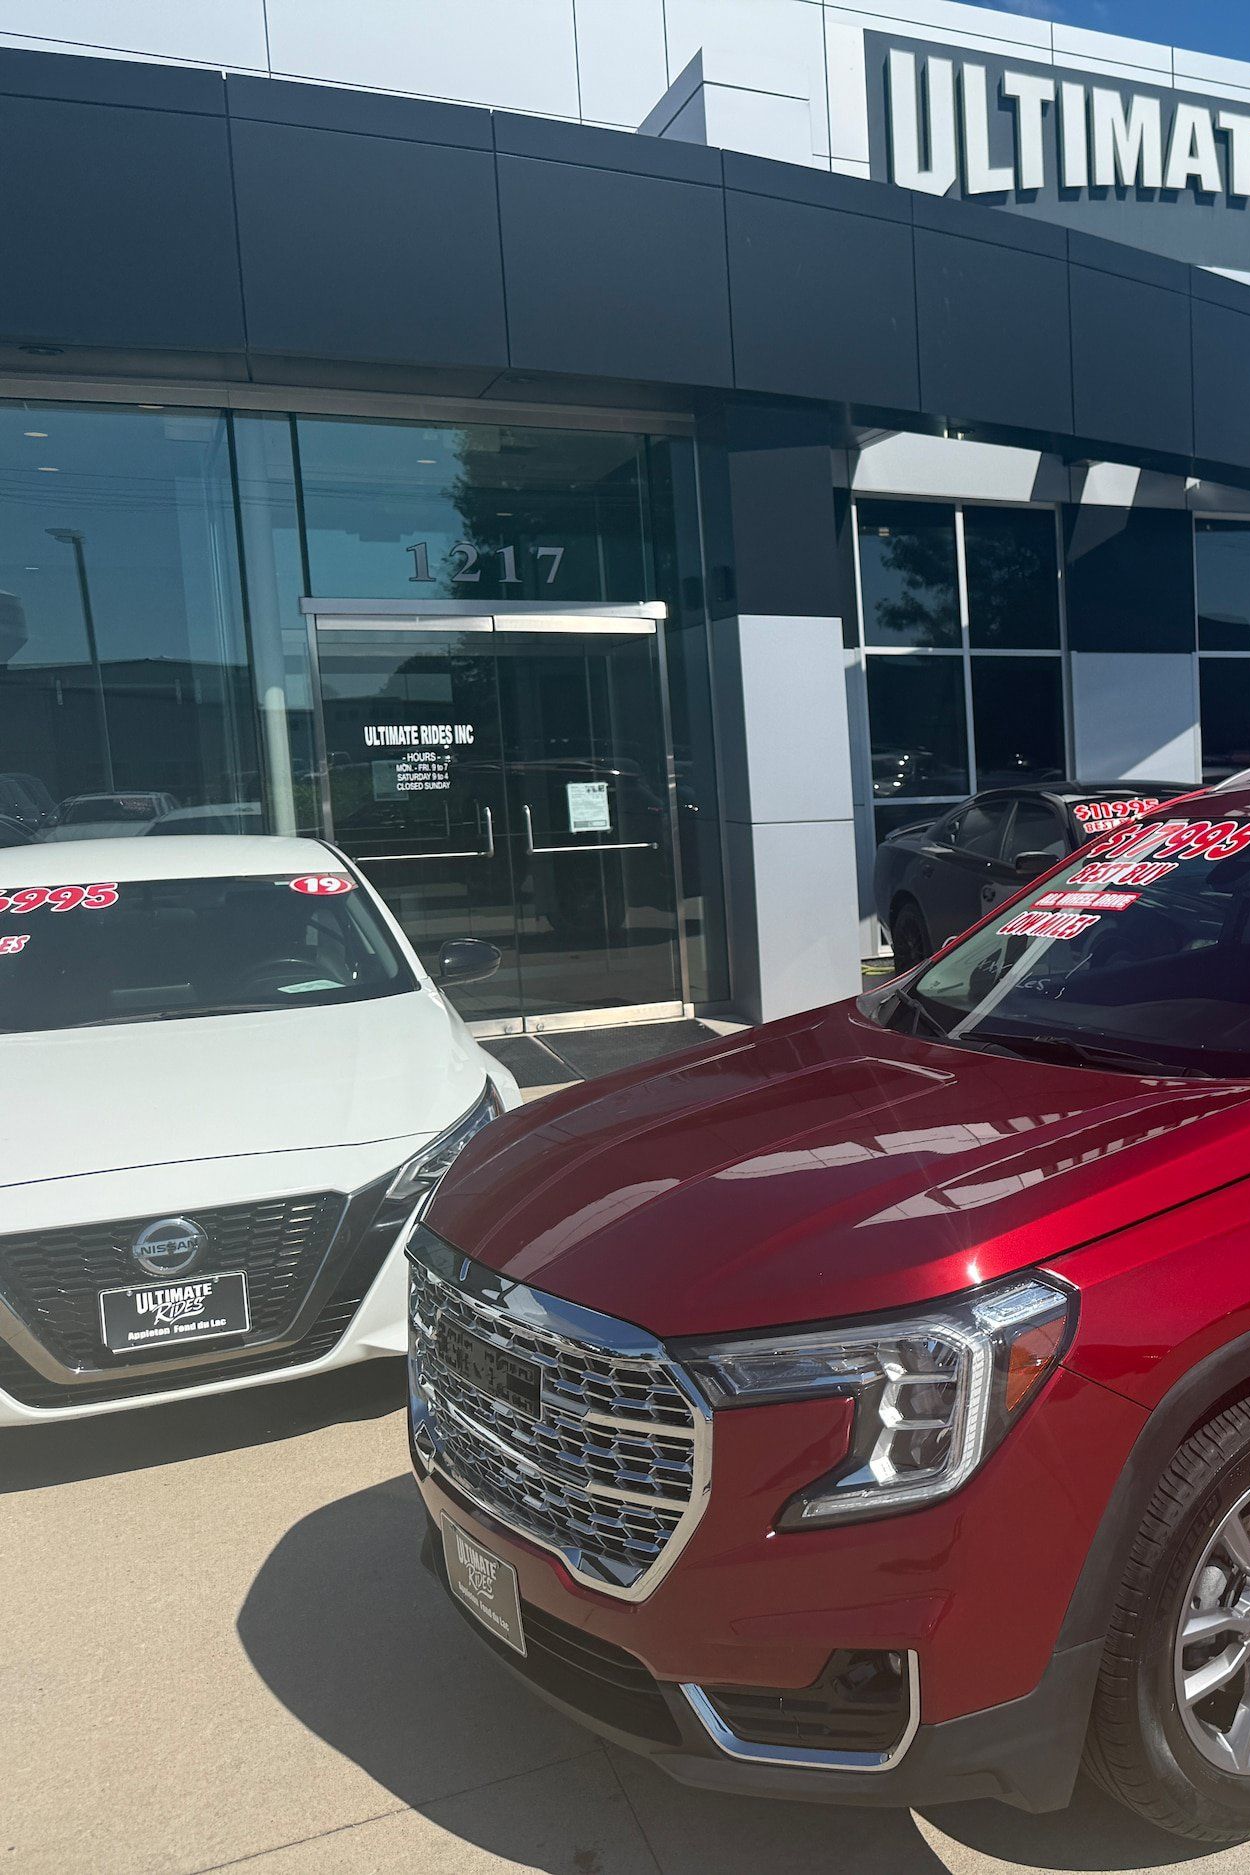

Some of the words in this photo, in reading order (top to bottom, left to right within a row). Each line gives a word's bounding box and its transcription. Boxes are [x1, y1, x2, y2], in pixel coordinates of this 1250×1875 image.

[406, 541, 565, 584] 1217
[364, 725, 419, 746] ULTIMATE
[420, 725, 453, 745] RIDES
[454, 725, 474, 744] INC
[407, 752, 436, 762] HOURS
[396, 782, 423, 791] CLOSED
[424, 782, 451, 790] SUNDAY
[397, 773, 431, 781] SATURDAY
[1066, 861, 1131, 885] BEST
[1116, 861, 1179, 886] BUY
[304, 877, 342, 892] 19
[0, 883, 119, 913] 995
[996, 911, 1046, 937] LOW
[1024, 912, 1101, 940] MILES
[140, 1237, 198, 1255] NISSAN
[135, 1282, 212, 1315] ULTIMATE
[173, 1322, 196, 1333] Fond
[210, 1319, 227, 1328] Lac
[456, 1534, 497, 1580] ULTIMATE
